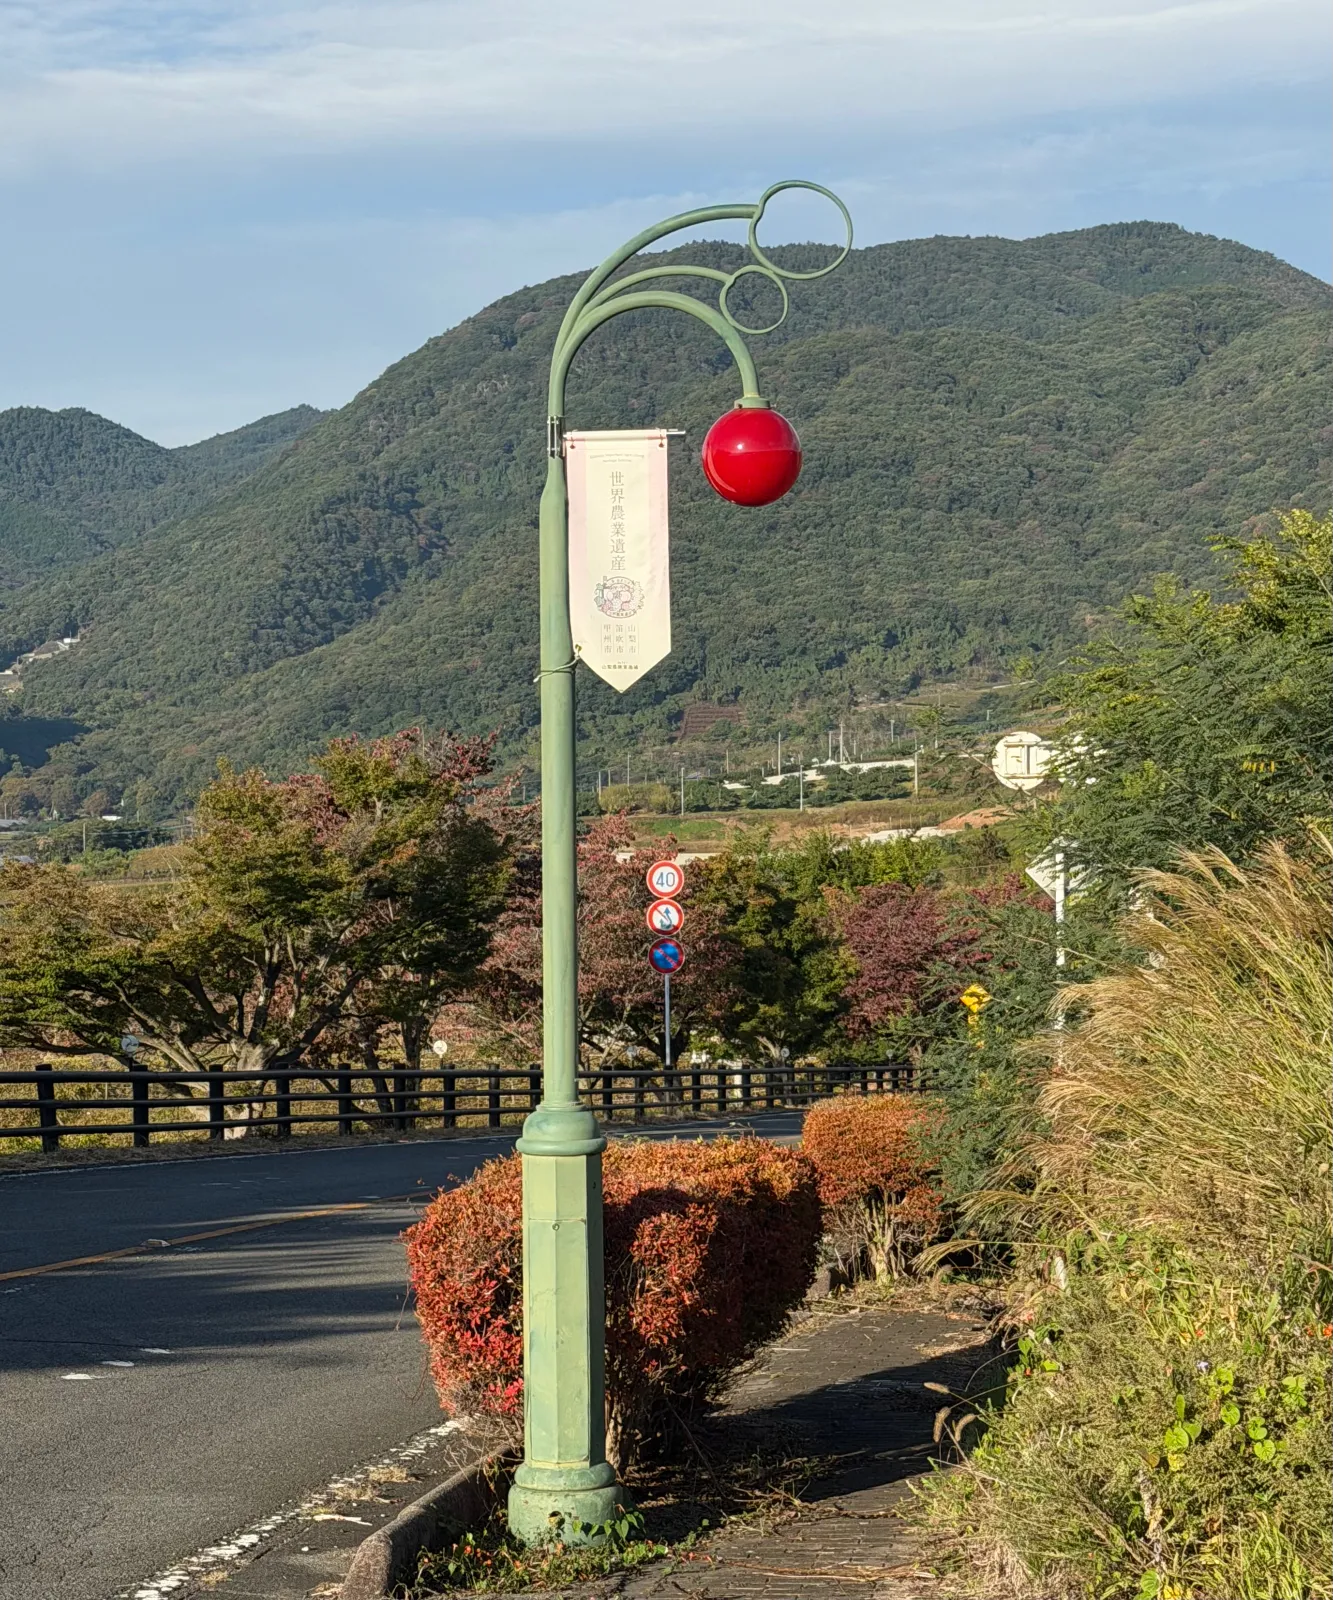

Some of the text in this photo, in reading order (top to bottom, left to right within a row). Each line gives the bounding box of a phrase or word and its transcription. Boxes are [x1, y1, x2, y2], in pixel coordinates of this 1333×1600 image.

[609, 471, 626, 571] 世界農業遺産
[603, 624, 612, 654] 甲州市
[627, 624, 637, 654] 山梨市
[656, 872, 675, 887] 40
